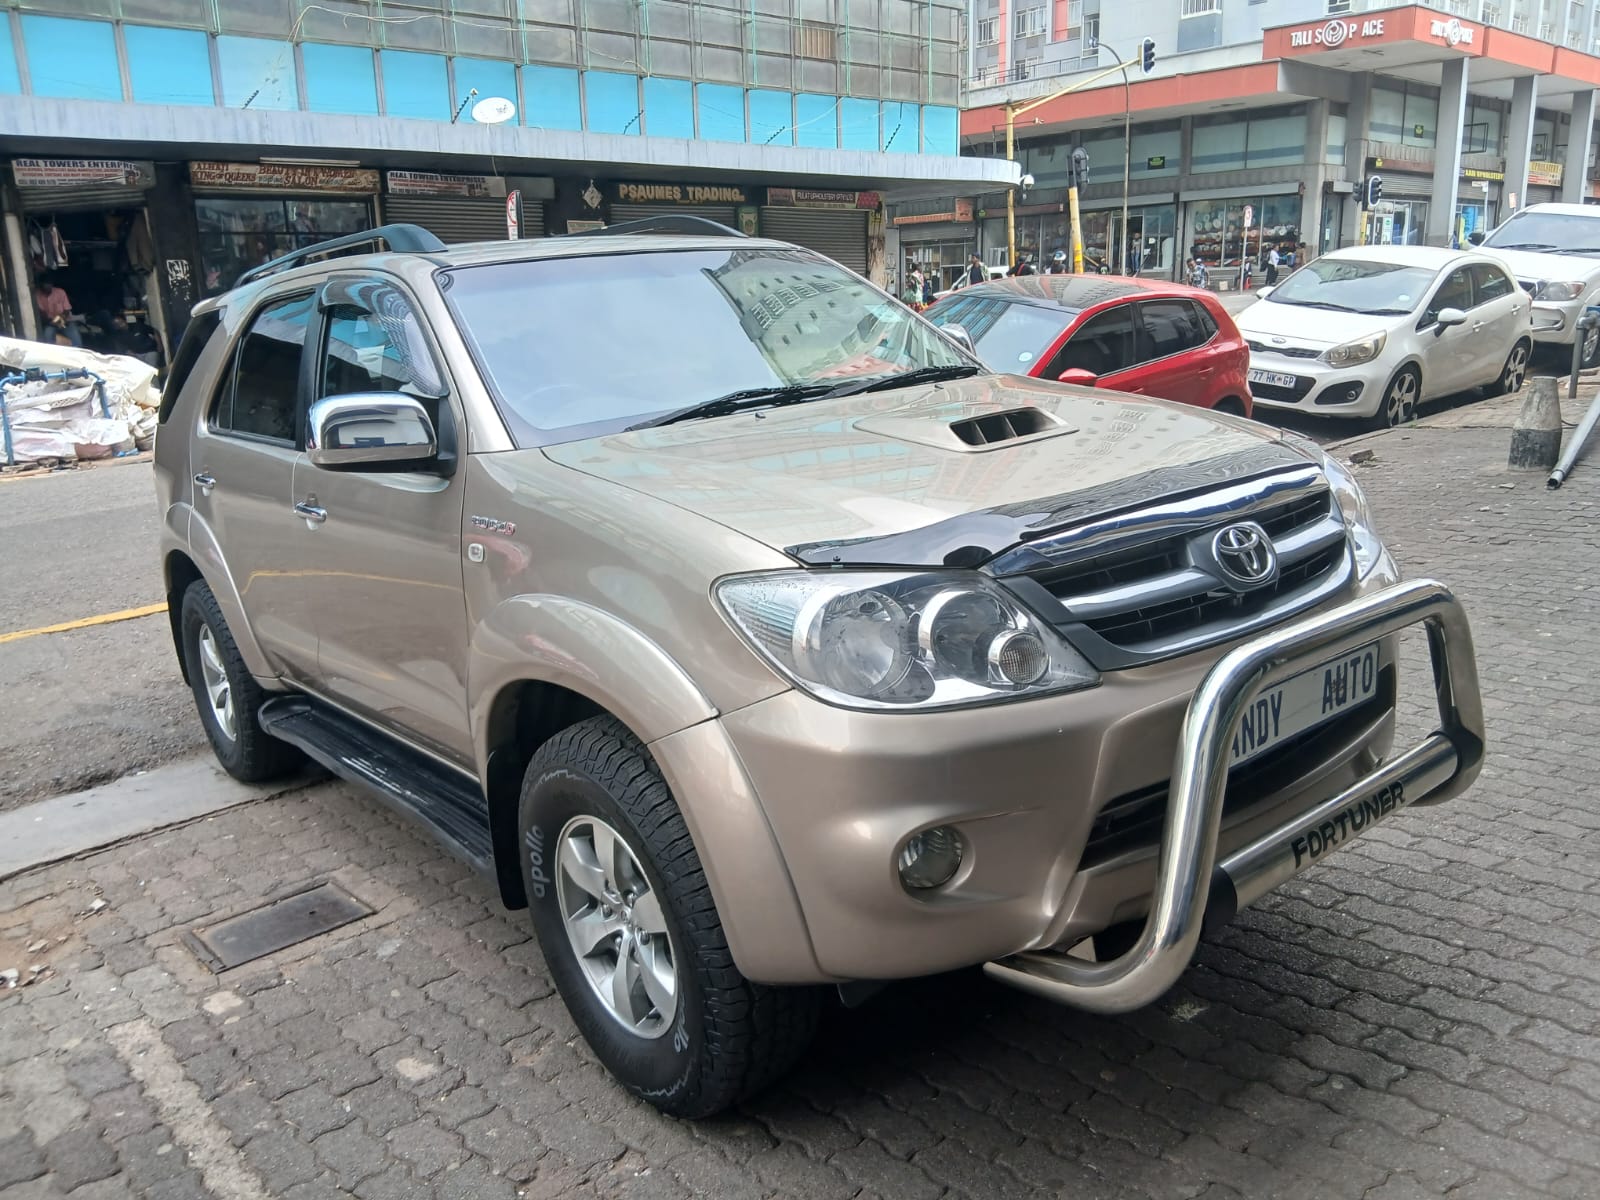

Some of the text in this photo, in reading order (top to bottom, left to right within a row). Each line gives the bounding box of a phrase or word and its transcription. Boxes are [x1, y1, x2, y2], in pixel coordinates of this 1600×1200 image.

[1290, 30, 1313, 47] TALI
[1361, 19, 1385, 37] ACE
[15, 160, 40, 168] REAL
[43, 160, 85, 168] TOWERS
[390, 171, 408, 179] REAL
[619, 183, 682, 200] PSAUMES
[1253, 370, 1294, 386] 77 HK GP
[1321, 651, 1373, 714] AUTO
[1290, 780, 1406, 869] FORTUNER
[526, 825, 551, 898] apollo
